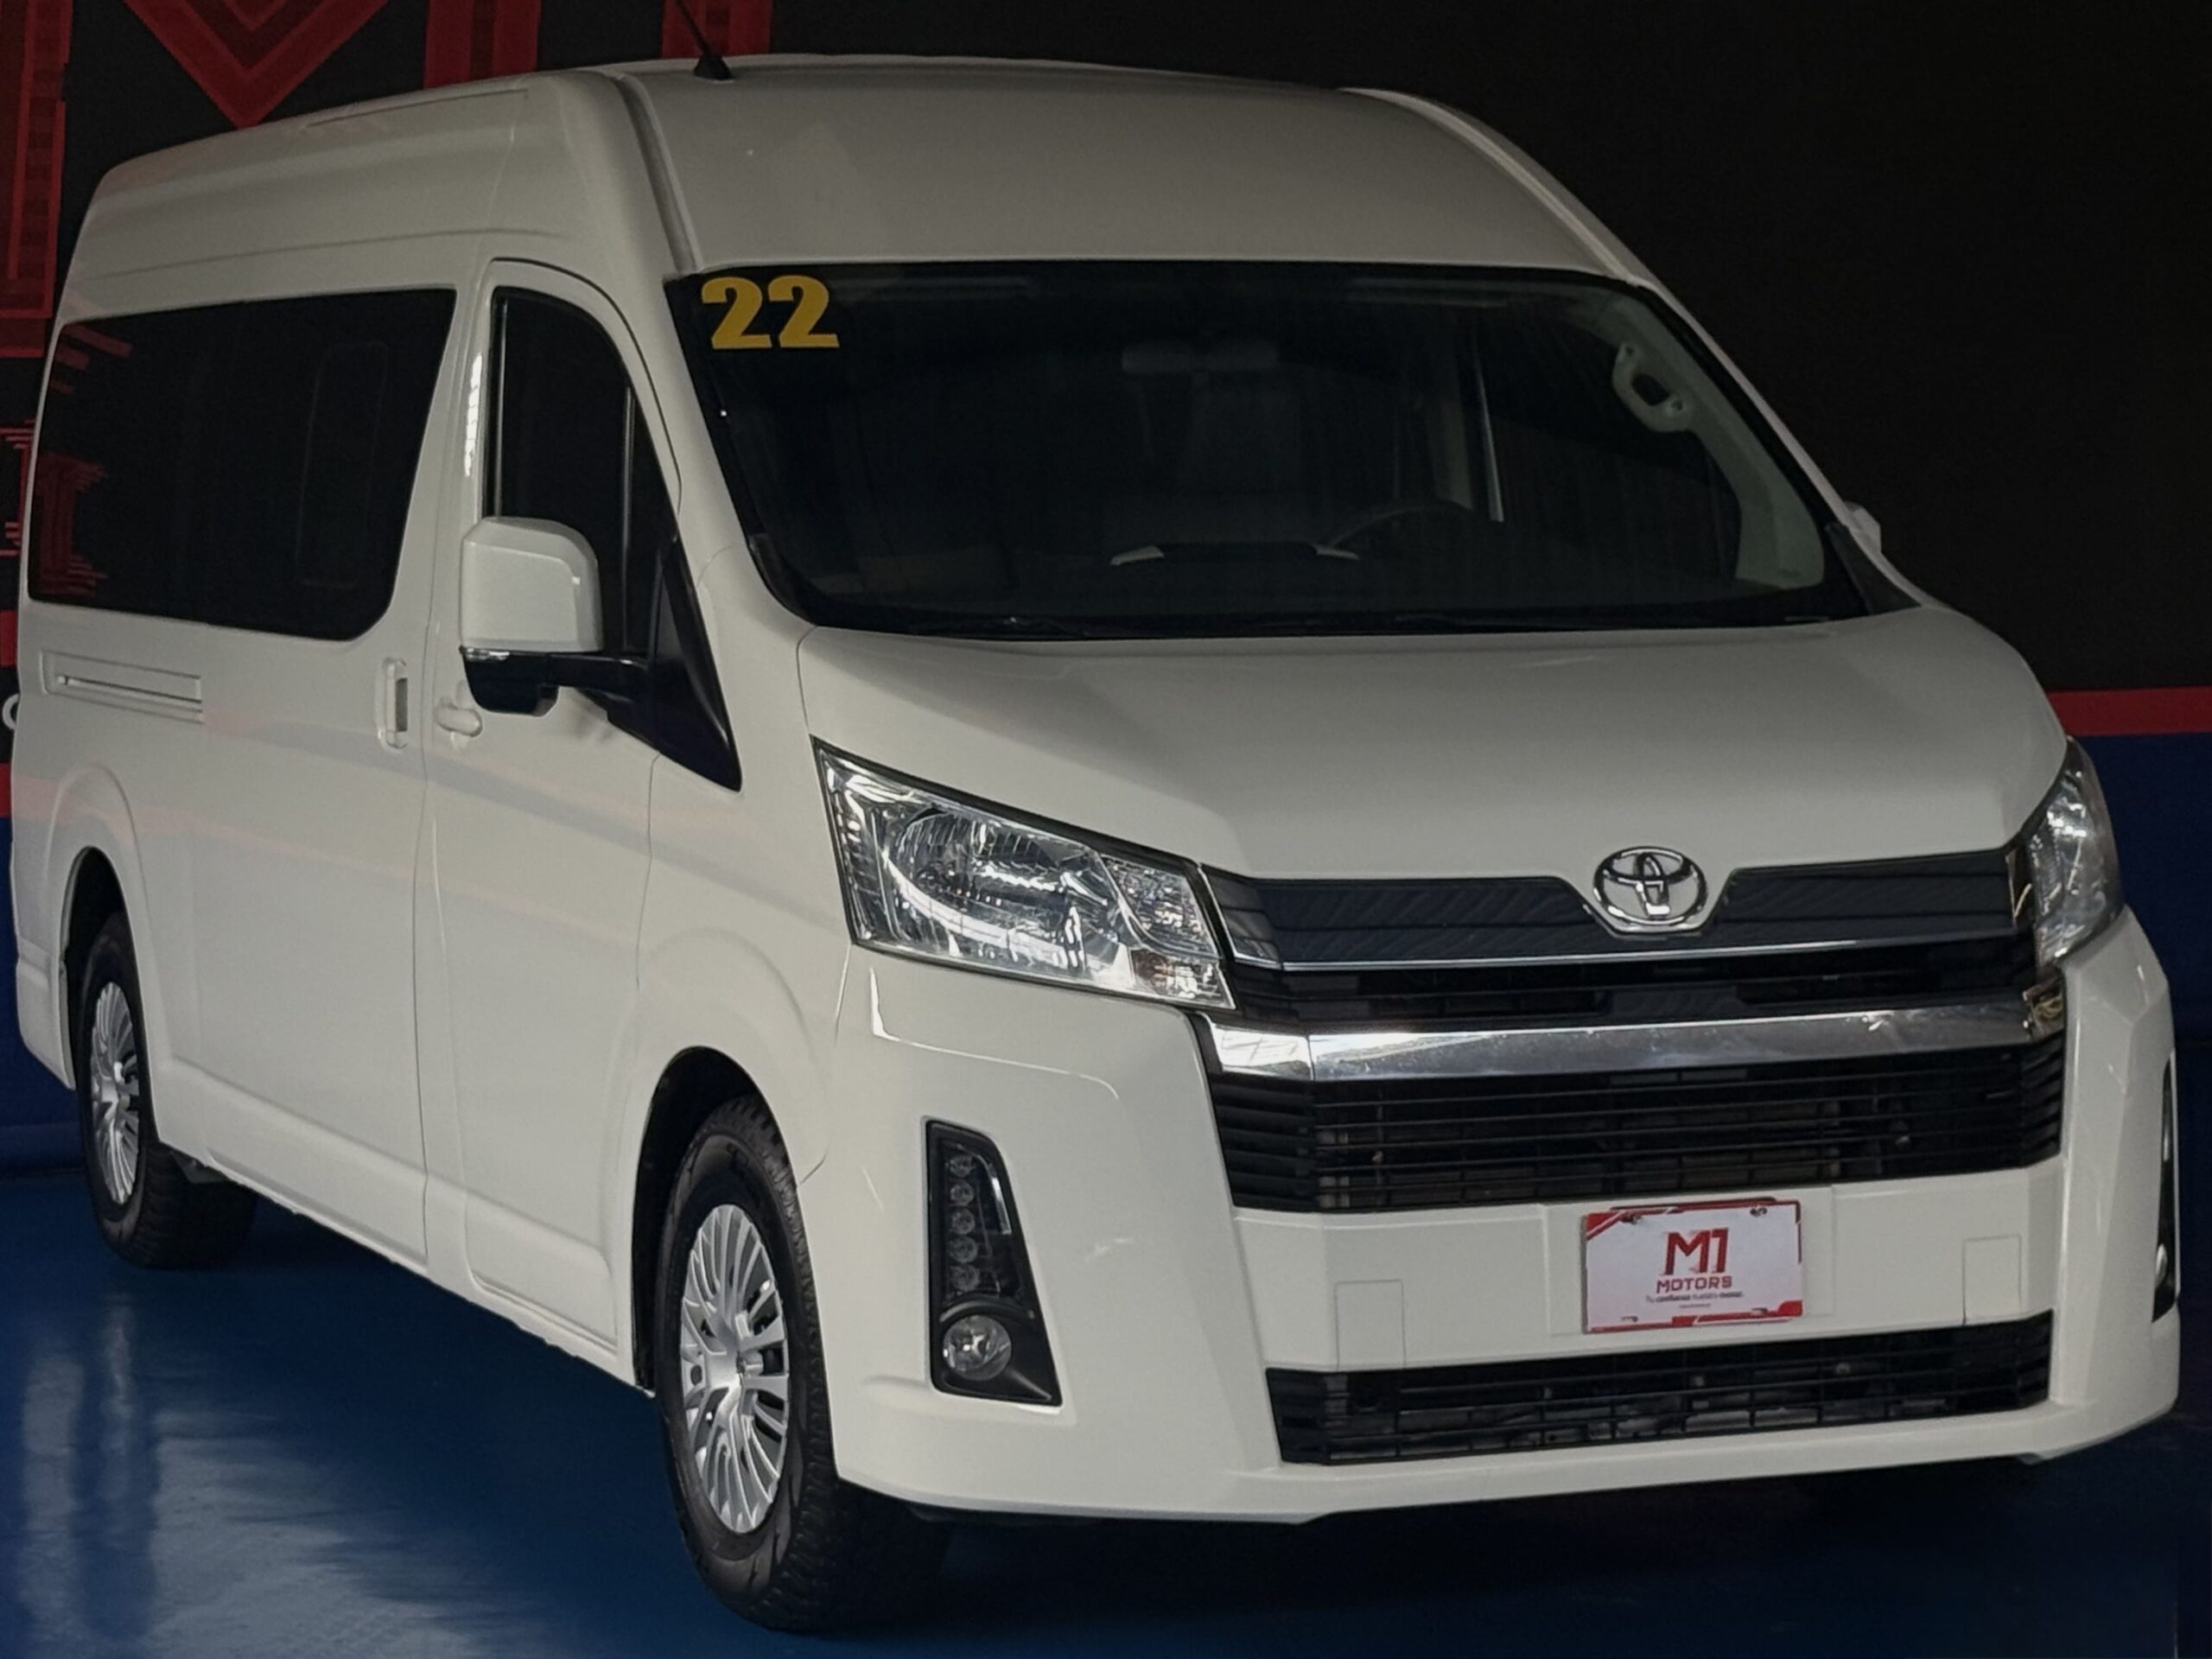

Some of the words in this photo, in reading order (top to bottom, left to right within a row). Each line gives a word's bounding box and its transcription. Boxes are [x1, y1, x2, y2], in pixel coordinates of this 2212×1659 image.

[701, 274, 841, 350] 22
[1662, 1227, 1729, 1275] M1
[1656, 1275, 1732, 1294] MOTORS
